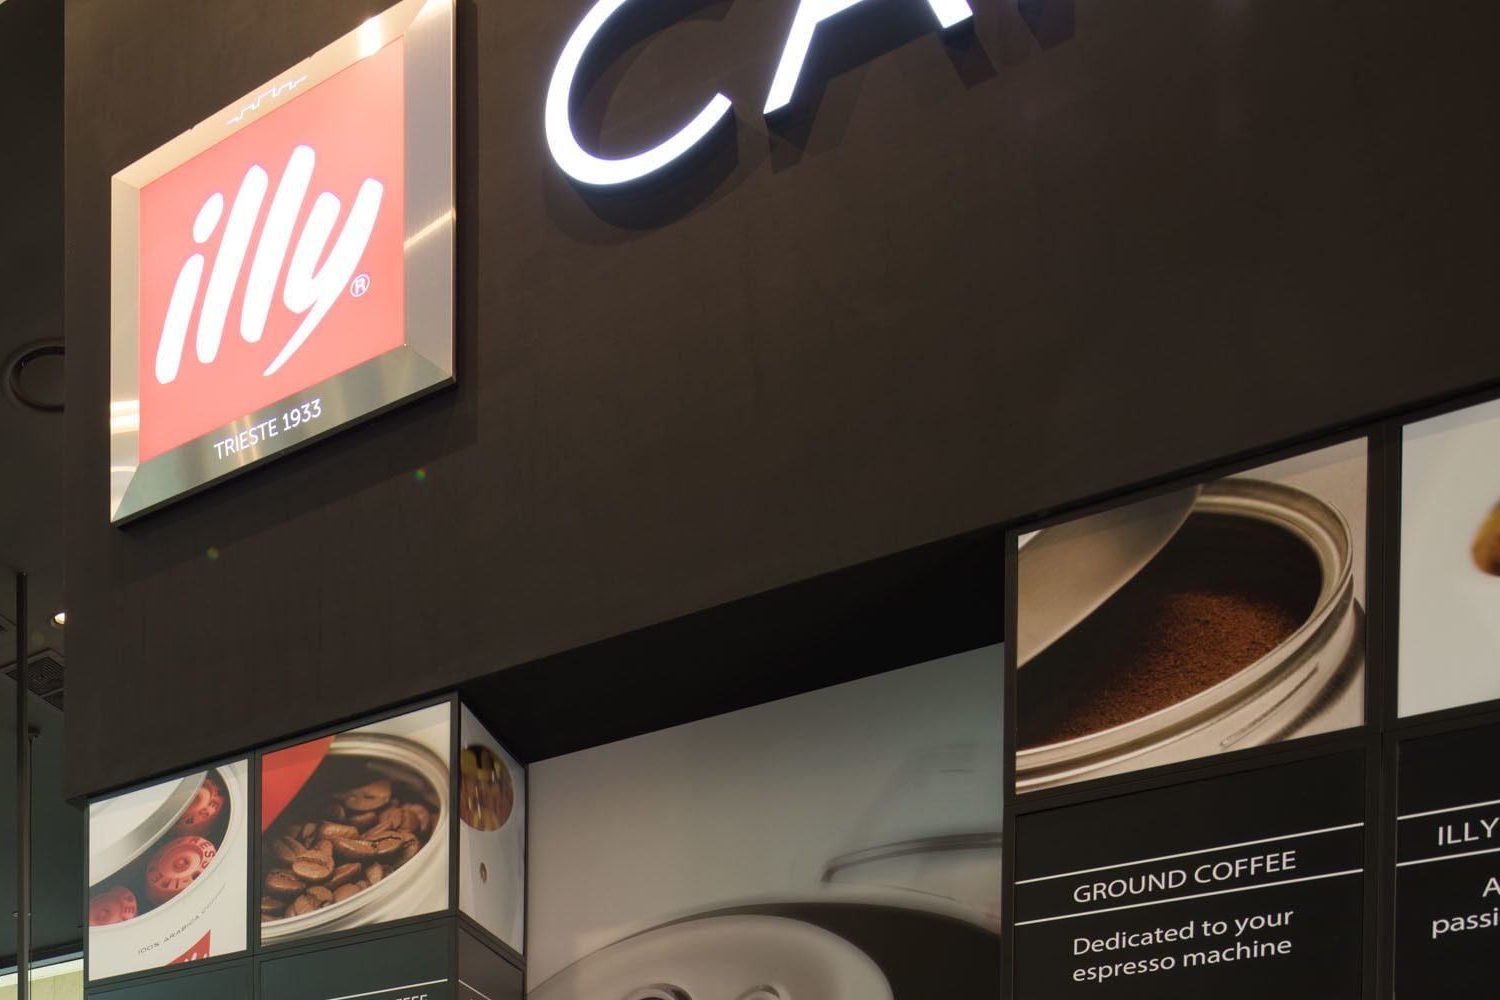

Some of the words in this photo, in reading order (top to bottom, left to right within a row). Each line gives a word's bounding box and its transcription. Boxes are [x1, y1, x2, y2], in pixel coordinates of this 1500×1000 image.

[155, 144, 384, 385] illy
[213, 417, 279, 460] TRIESTE
[283, 398, 322, 431] 1933
[1438, 817, 1500, 846] ILLY
[1073, 869, 1187, 903] GROUND
[1194, 850, 1297, 884] COFFEE
[1073, 920, 1194, 956] Dedicated
[1201, 919, 1228, 937] to
[1234, 910, 1294, 937] your
[1432, 907, 1499, 939] passi
[1072, 955, 1176, 983] espresso
[1183, 940, 1292, 967] machine
